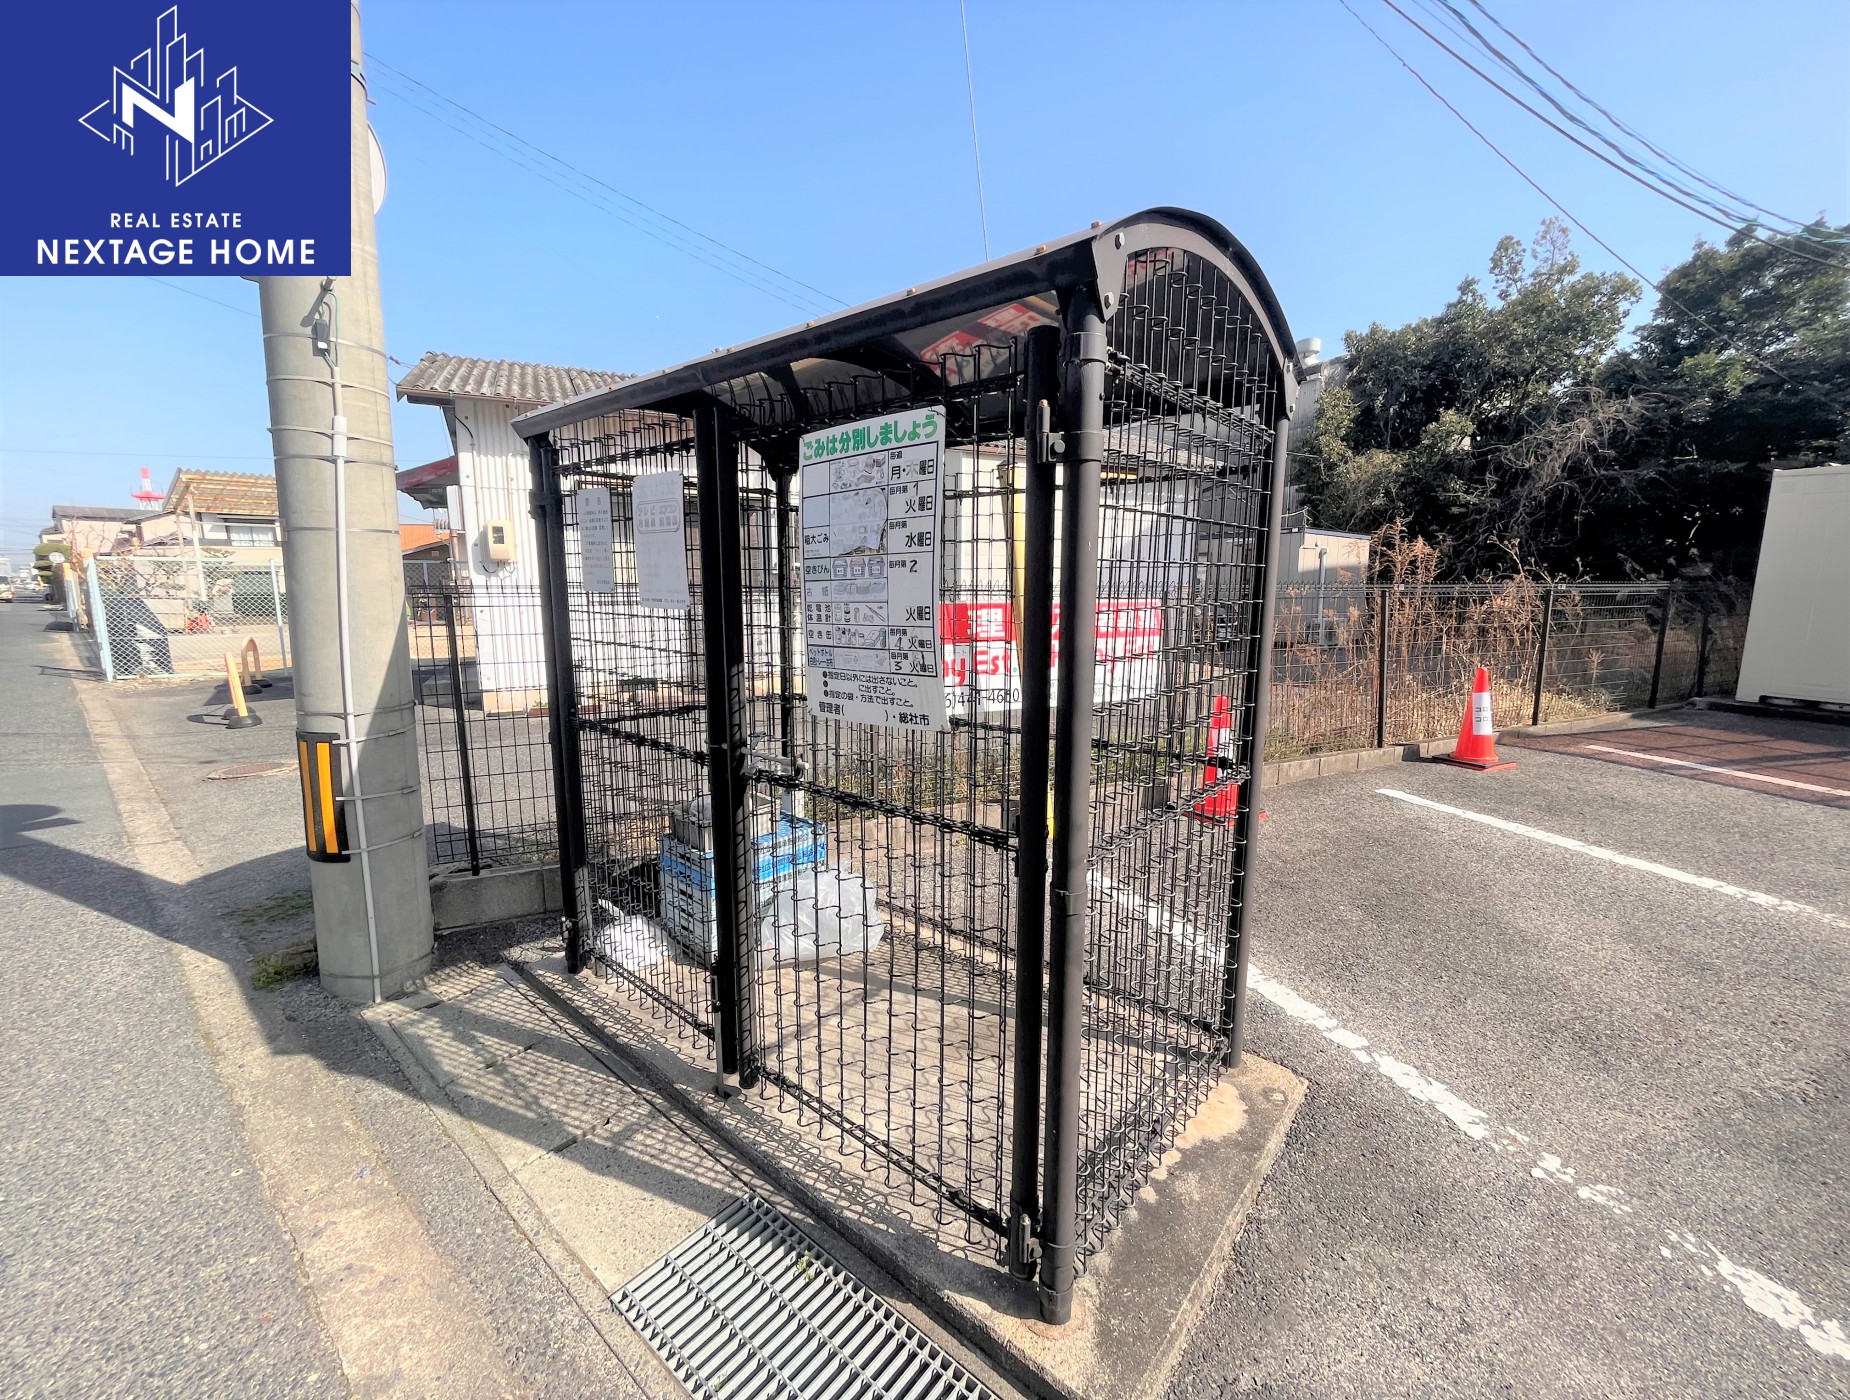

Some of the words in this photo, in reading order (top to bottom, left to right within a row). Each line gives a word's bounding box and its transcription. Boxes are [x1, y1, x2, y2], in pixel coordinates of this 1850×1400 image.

[803, 413, 938, 461] ごみは分別しましょう
[905, 495, 933, 513] 火曜日
[905, 531, 931, 548] 水曜日
[805, 564, 830, 575] 空きびん
[909, 559, 918, 573] 2
[905, 606, 930, 621] 火曜日
[908, 637, 932, 649] 火曜日
